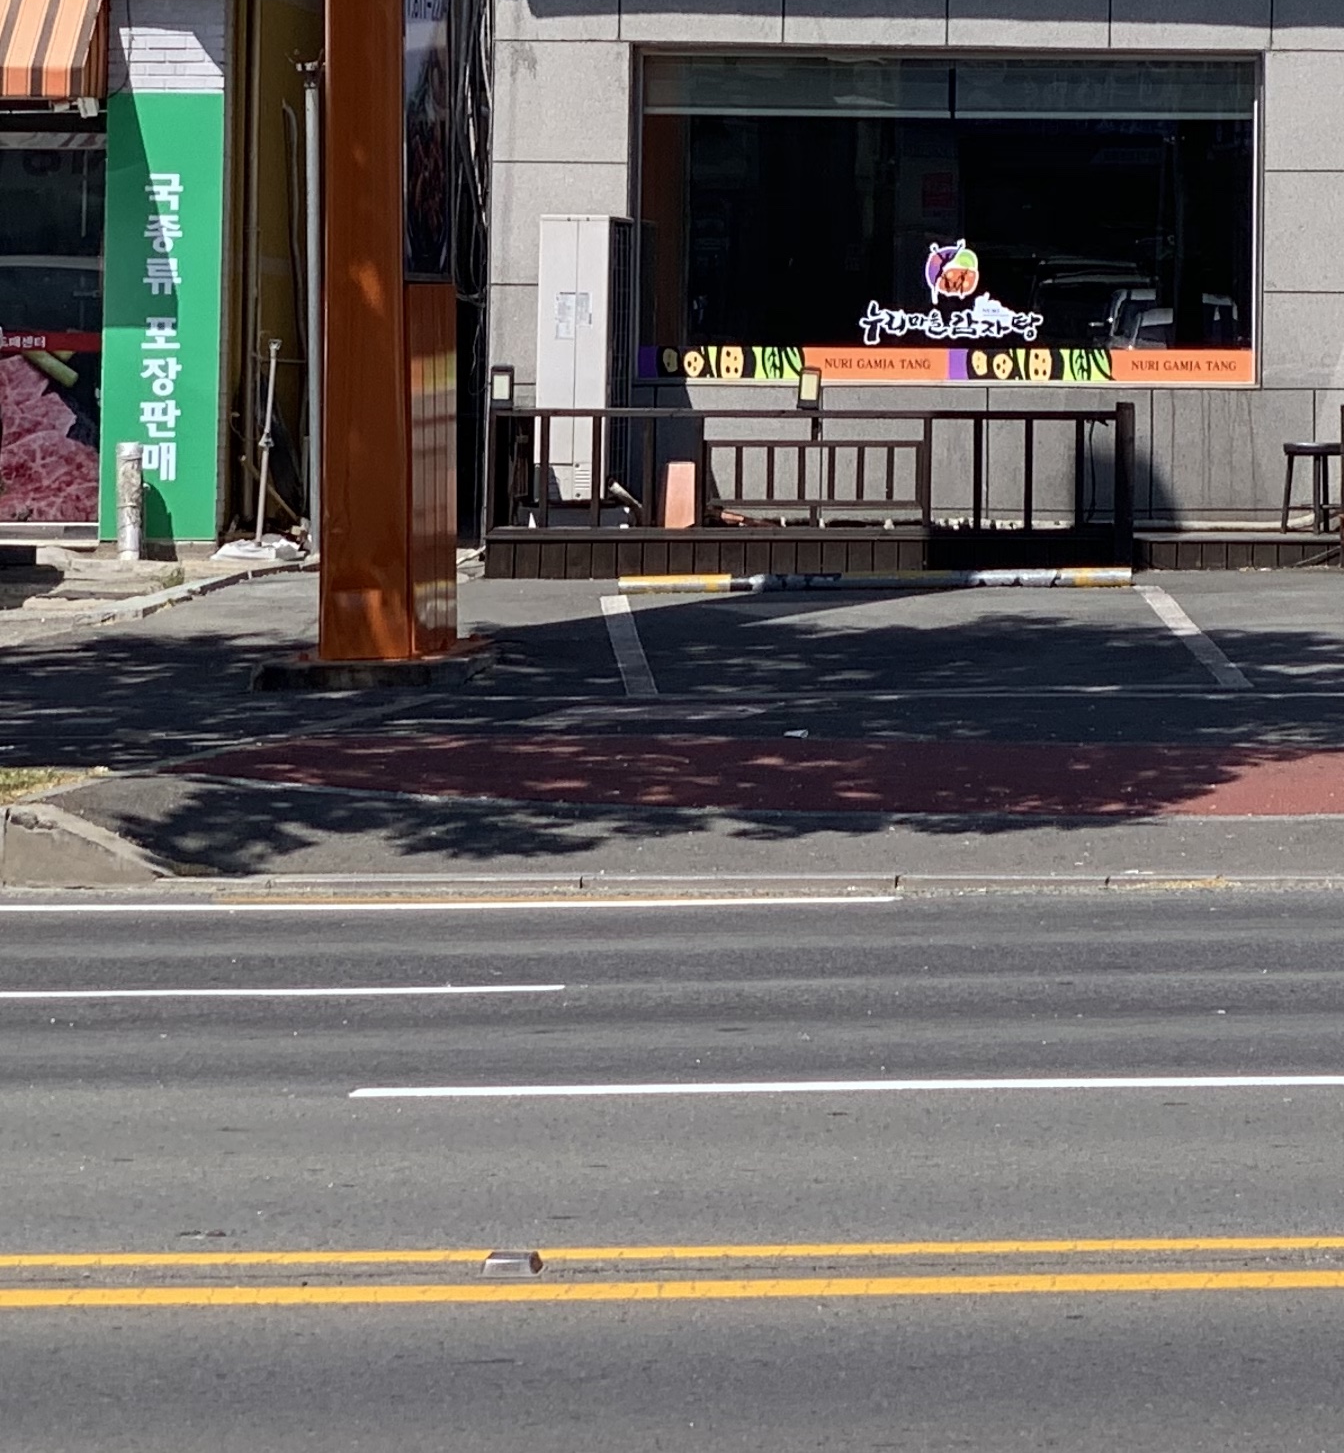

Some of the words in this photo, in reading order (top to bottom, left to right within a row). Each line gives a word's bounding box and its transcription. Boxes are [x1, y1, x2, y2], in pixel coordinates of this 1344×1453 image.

[142, 172, 184, 296] 국종류
[824, 358, 852, 369] NURI
[857, 358, 894, 370] GAMJA
[900, 358, 931, 370] TANG
[1131, 360, 1159, 371] NURI
[1163, 360, 1201, 372] GAMJA
[1205, 360, 1237, 371] TANG
[140, 316, 182, 482] 포장판매
